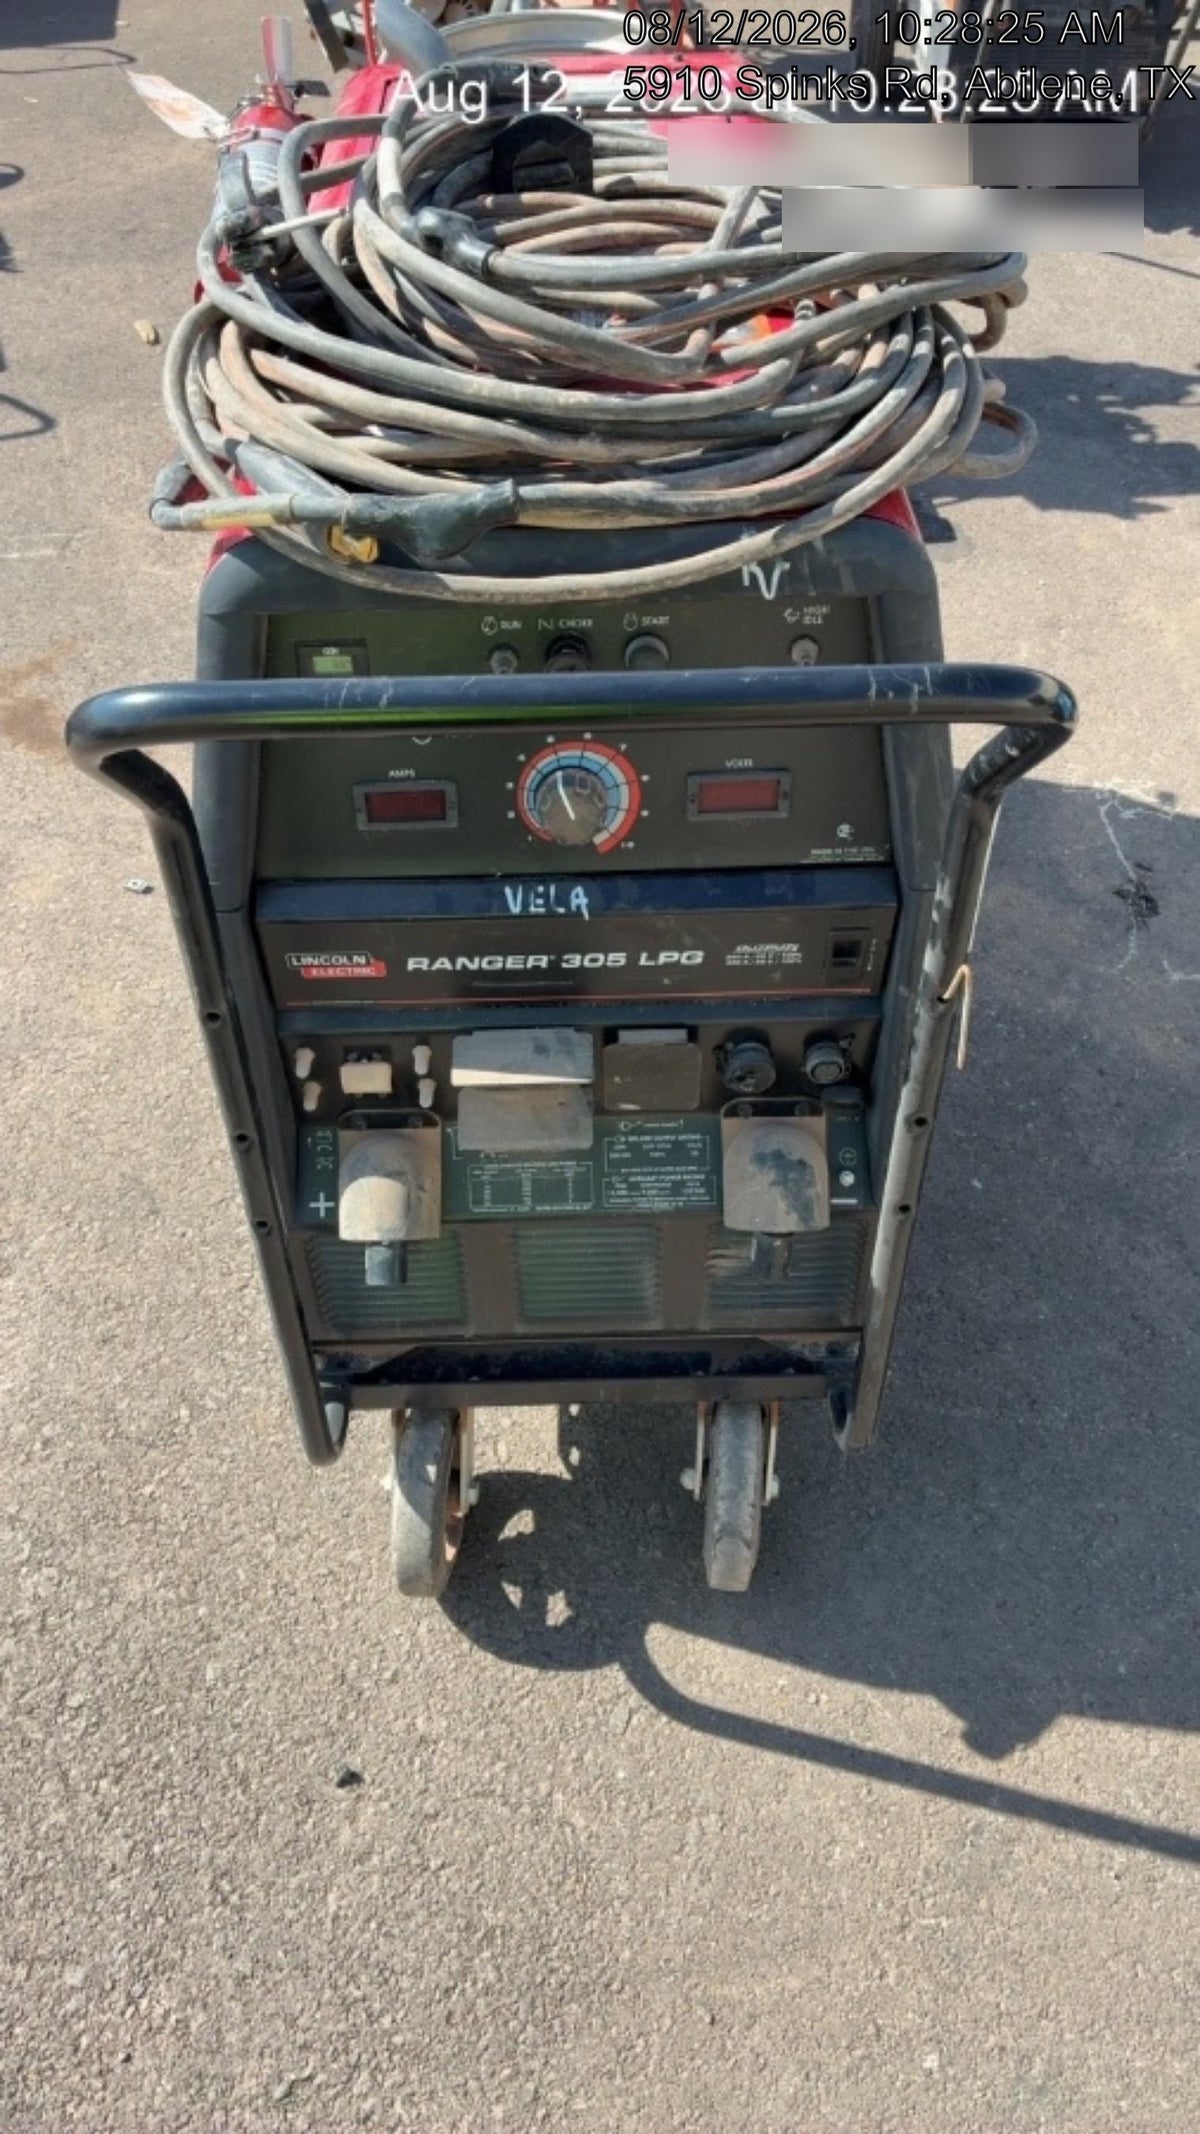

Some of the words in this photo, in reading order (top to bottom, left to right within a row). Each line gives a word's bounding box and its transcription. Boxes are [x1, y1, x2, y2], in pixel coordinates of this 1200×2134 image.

[505, 884, 590, 921] VELA
[290, 953, 369, 968] LINCOLN
[406, 955, 549, 972] RANGER
[561, 952, 627, 969] 305
[638, 950, 705, 967] LPG
[311, 965, 377, 978] ELECTRIC
